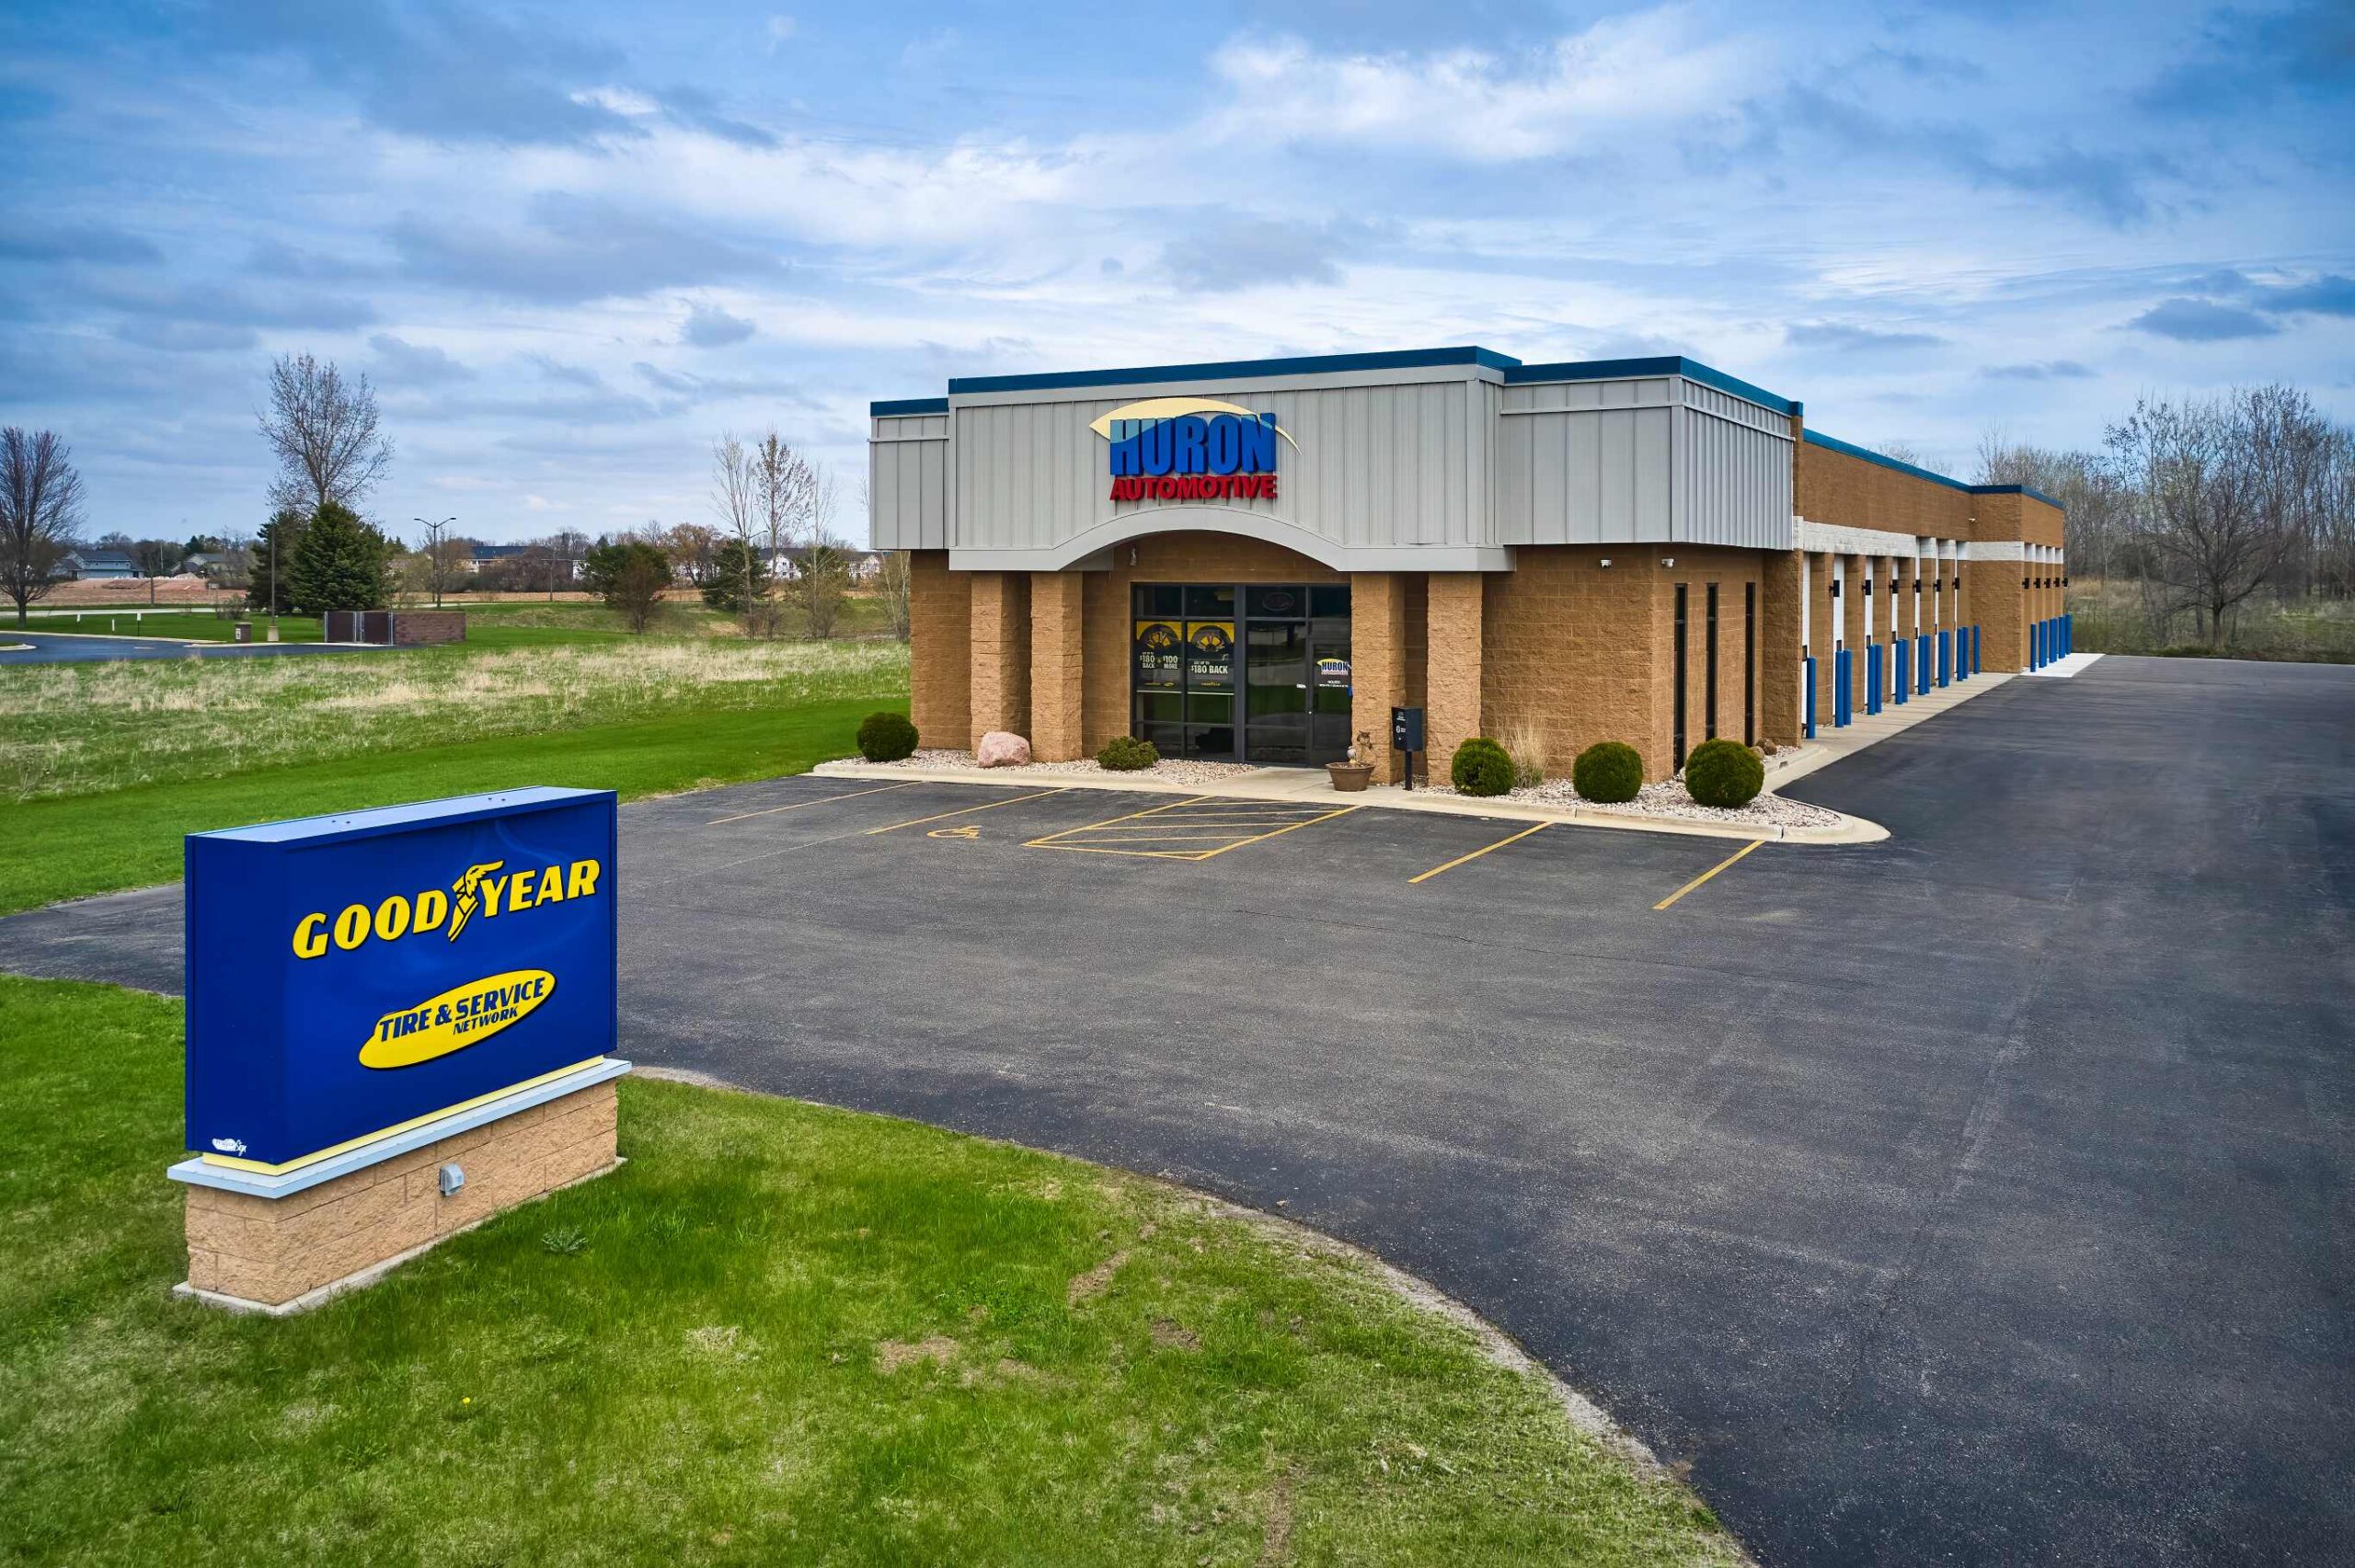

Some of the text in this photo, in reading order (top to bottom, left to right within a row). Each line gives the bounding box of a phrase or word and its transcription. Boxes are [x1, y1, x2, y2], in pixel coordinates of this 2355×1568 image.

[1110, 413, 1276, 475] HURON
[1109, 475, 1278, 500] AUTOMOTIVE
[1163, 655, 1178, 663] $100
[1191, 665, 1228, 674] $180 BACK
[1322, 661, 1349, 671] HURON
[292, 858, 601, 960] GOODYEAR
[379, 977, 546, 1042] TIRE & SERVICE
[453, 1006, 518, 1036] NETWORK
